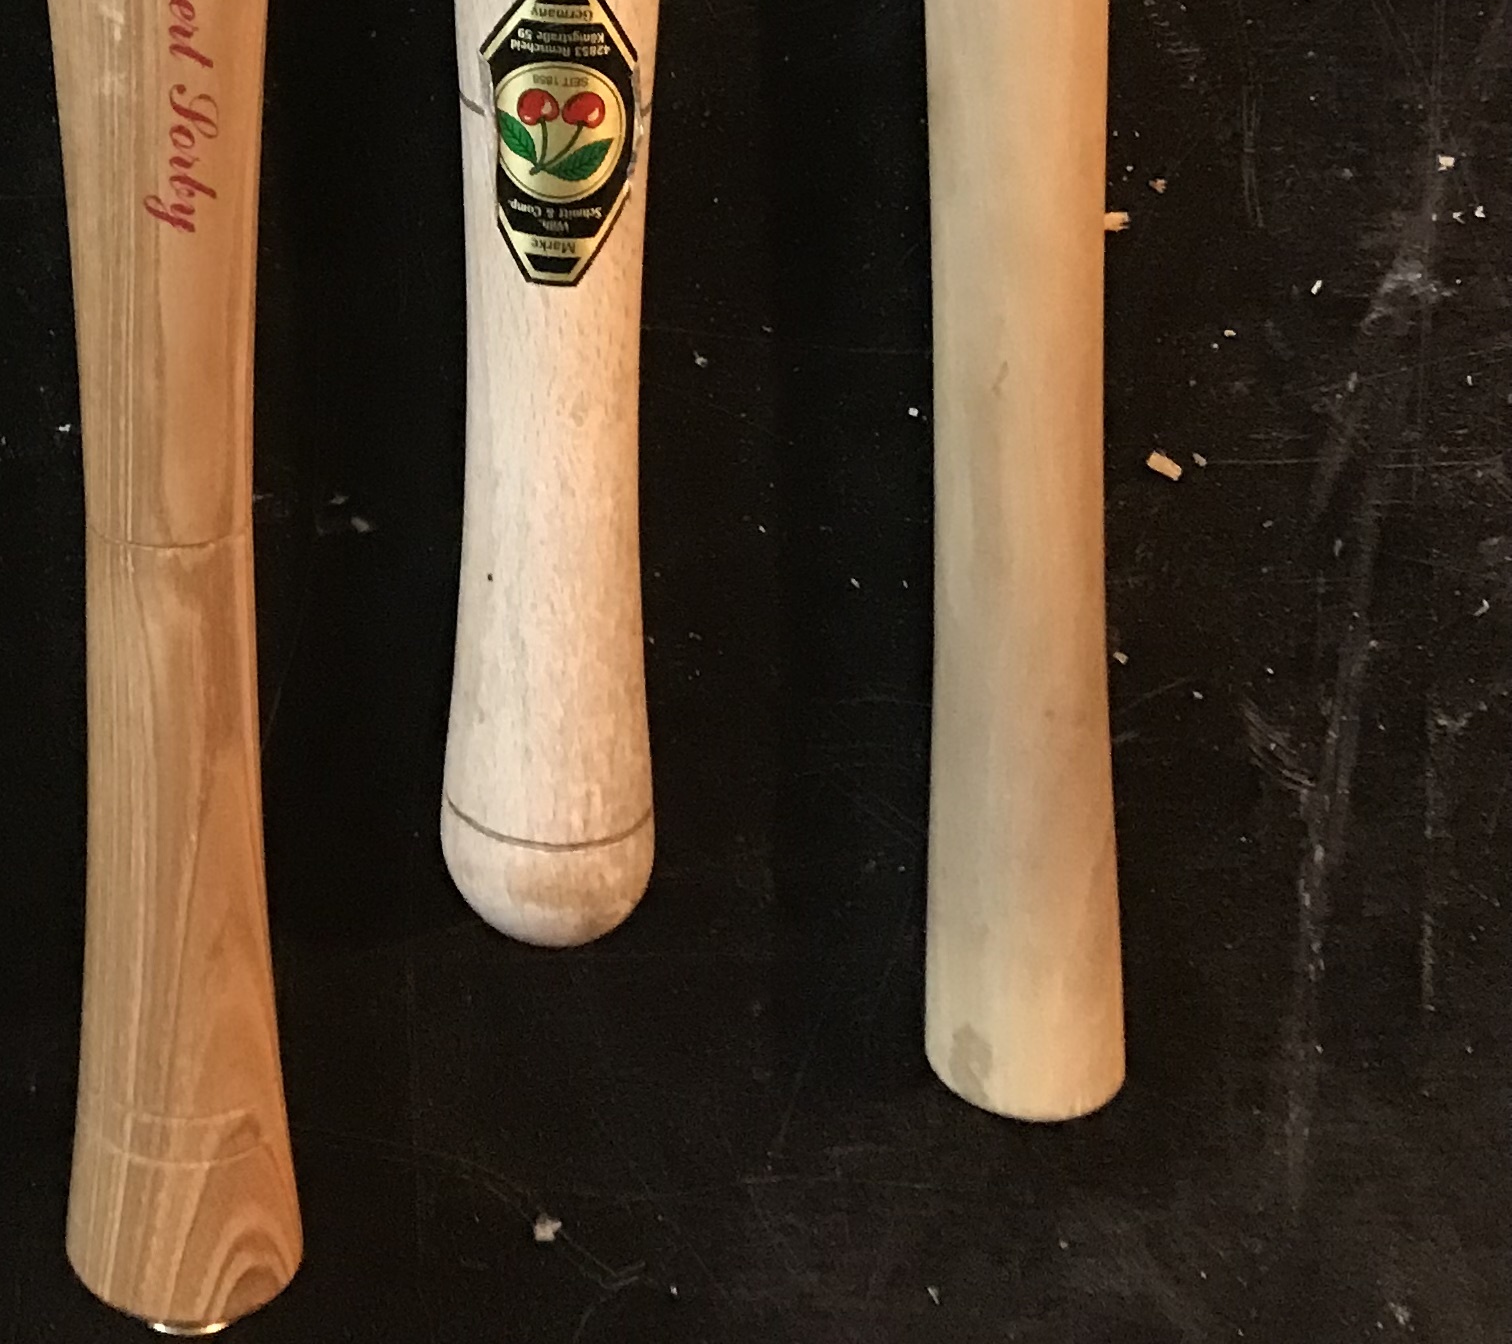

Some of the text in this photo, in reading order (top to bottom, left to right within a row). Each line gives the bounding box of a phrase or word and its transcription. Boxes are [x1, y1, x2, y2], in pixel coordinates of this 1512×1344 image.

[530, 6, 594, 22] Germany
[517, 27, 533, 39] 59
[561, 76, 589, 88] SEIT
[143, 84, 219, 232] Sorby
[531, 238, 577, 254] Marke
